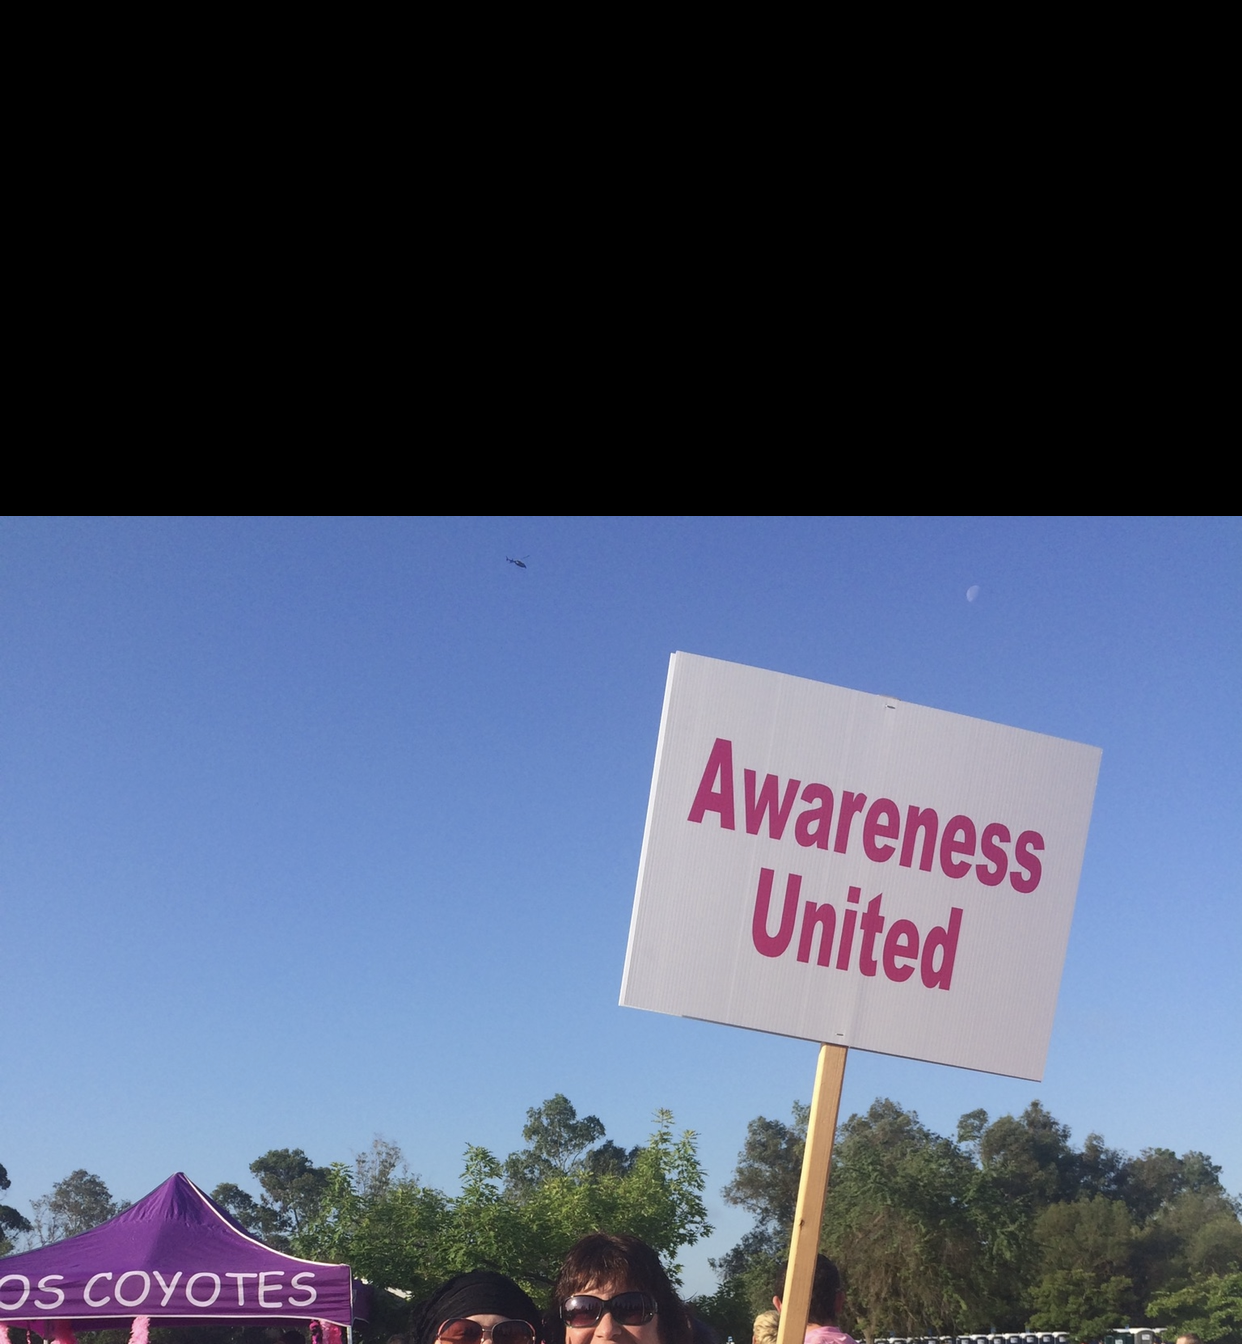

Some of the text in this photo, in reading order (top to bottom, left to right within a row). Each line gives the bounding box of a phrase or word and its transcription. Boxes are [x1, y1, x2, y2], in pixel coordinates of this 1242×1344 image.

[687, 737, 1046, 894] Awareness
[752, 867, 964, 991] United
[0, 1270, 318, 1311] OS COYOTES
